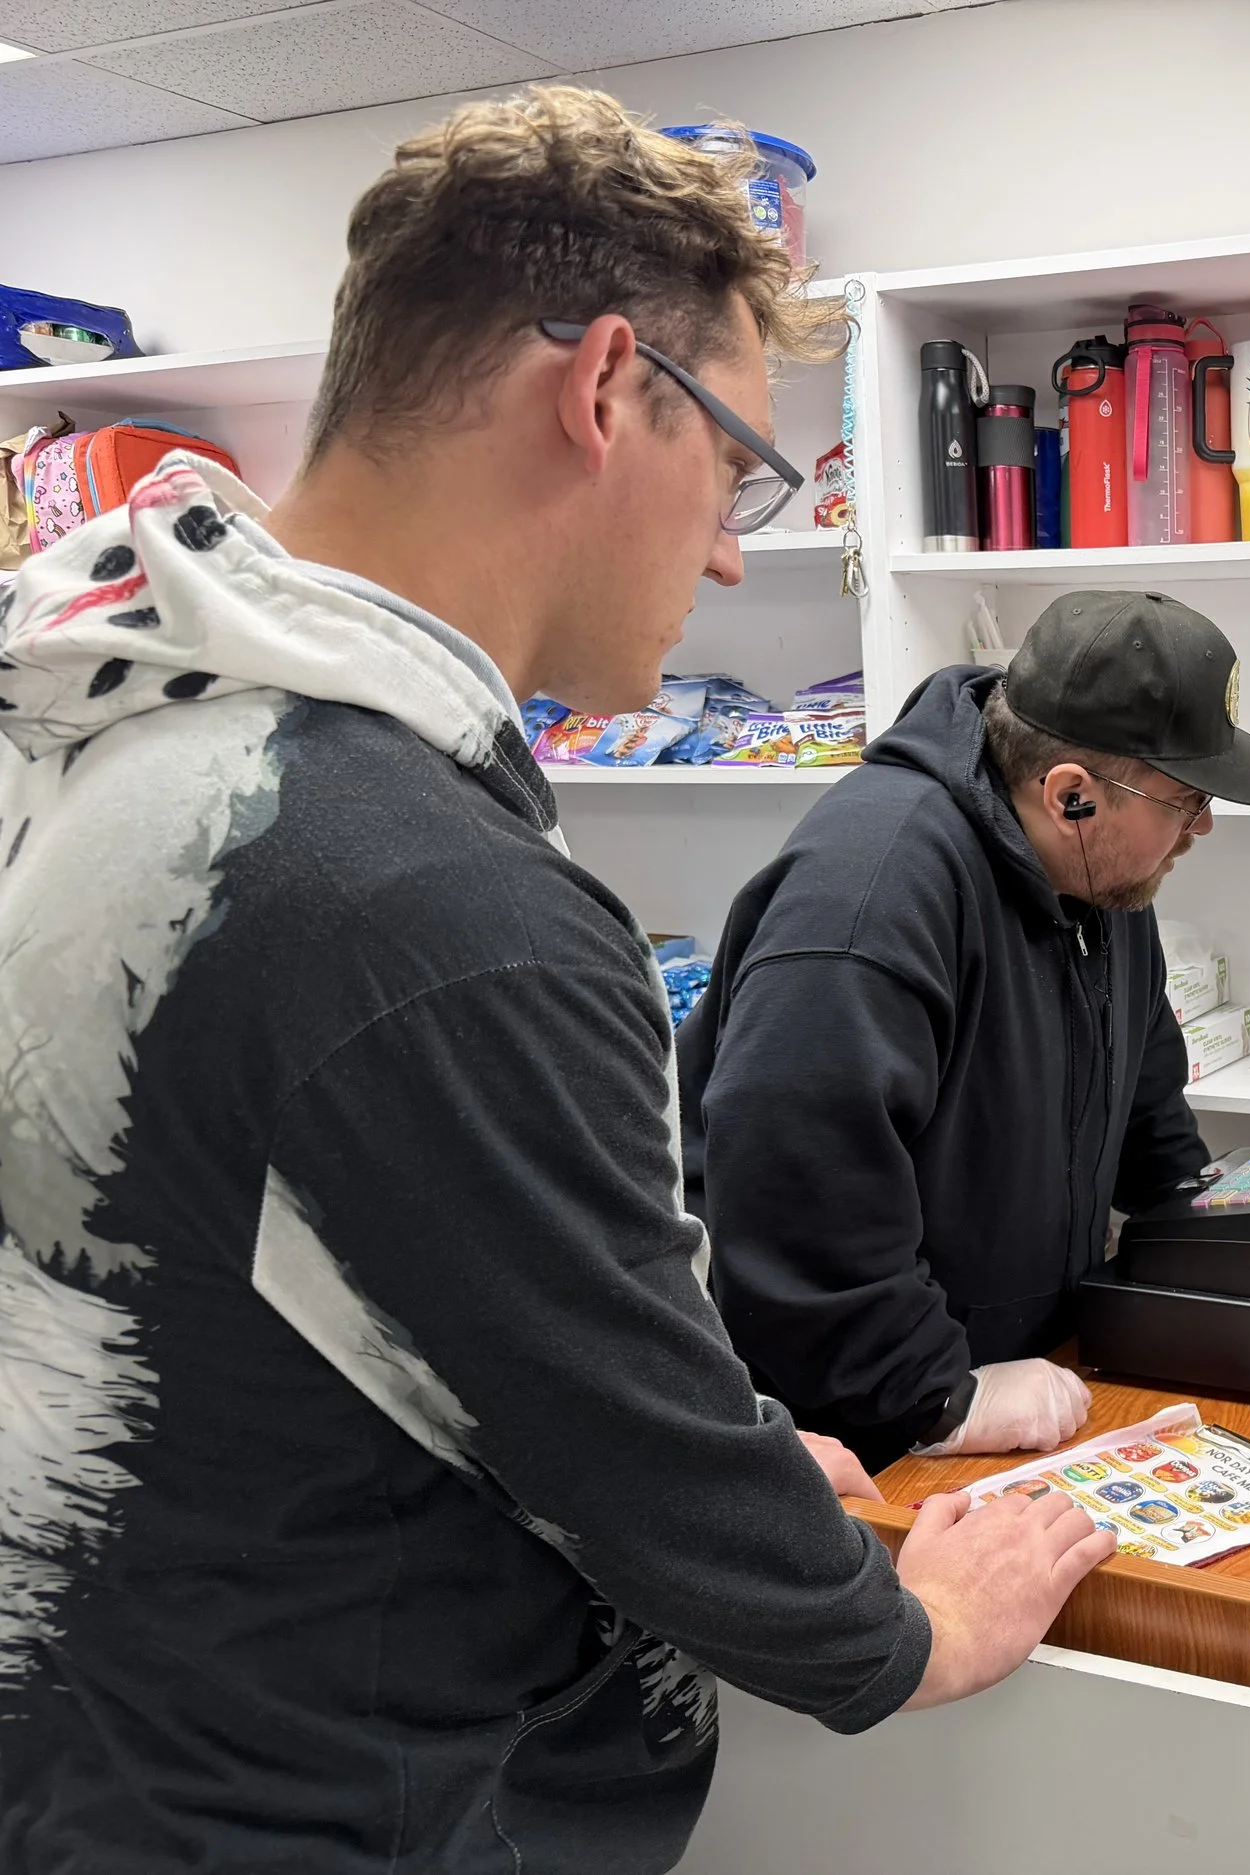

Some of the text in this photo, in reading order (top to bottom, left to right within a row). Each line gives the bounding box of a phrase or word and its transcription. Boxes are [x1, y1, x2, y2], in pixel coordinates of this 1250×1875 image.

[1103, 462, 1111, 512] ThermoFlask
[1206, 1448, 1232, 1464] NOR
[1211, 1465, 1238, 1482] CAFE
